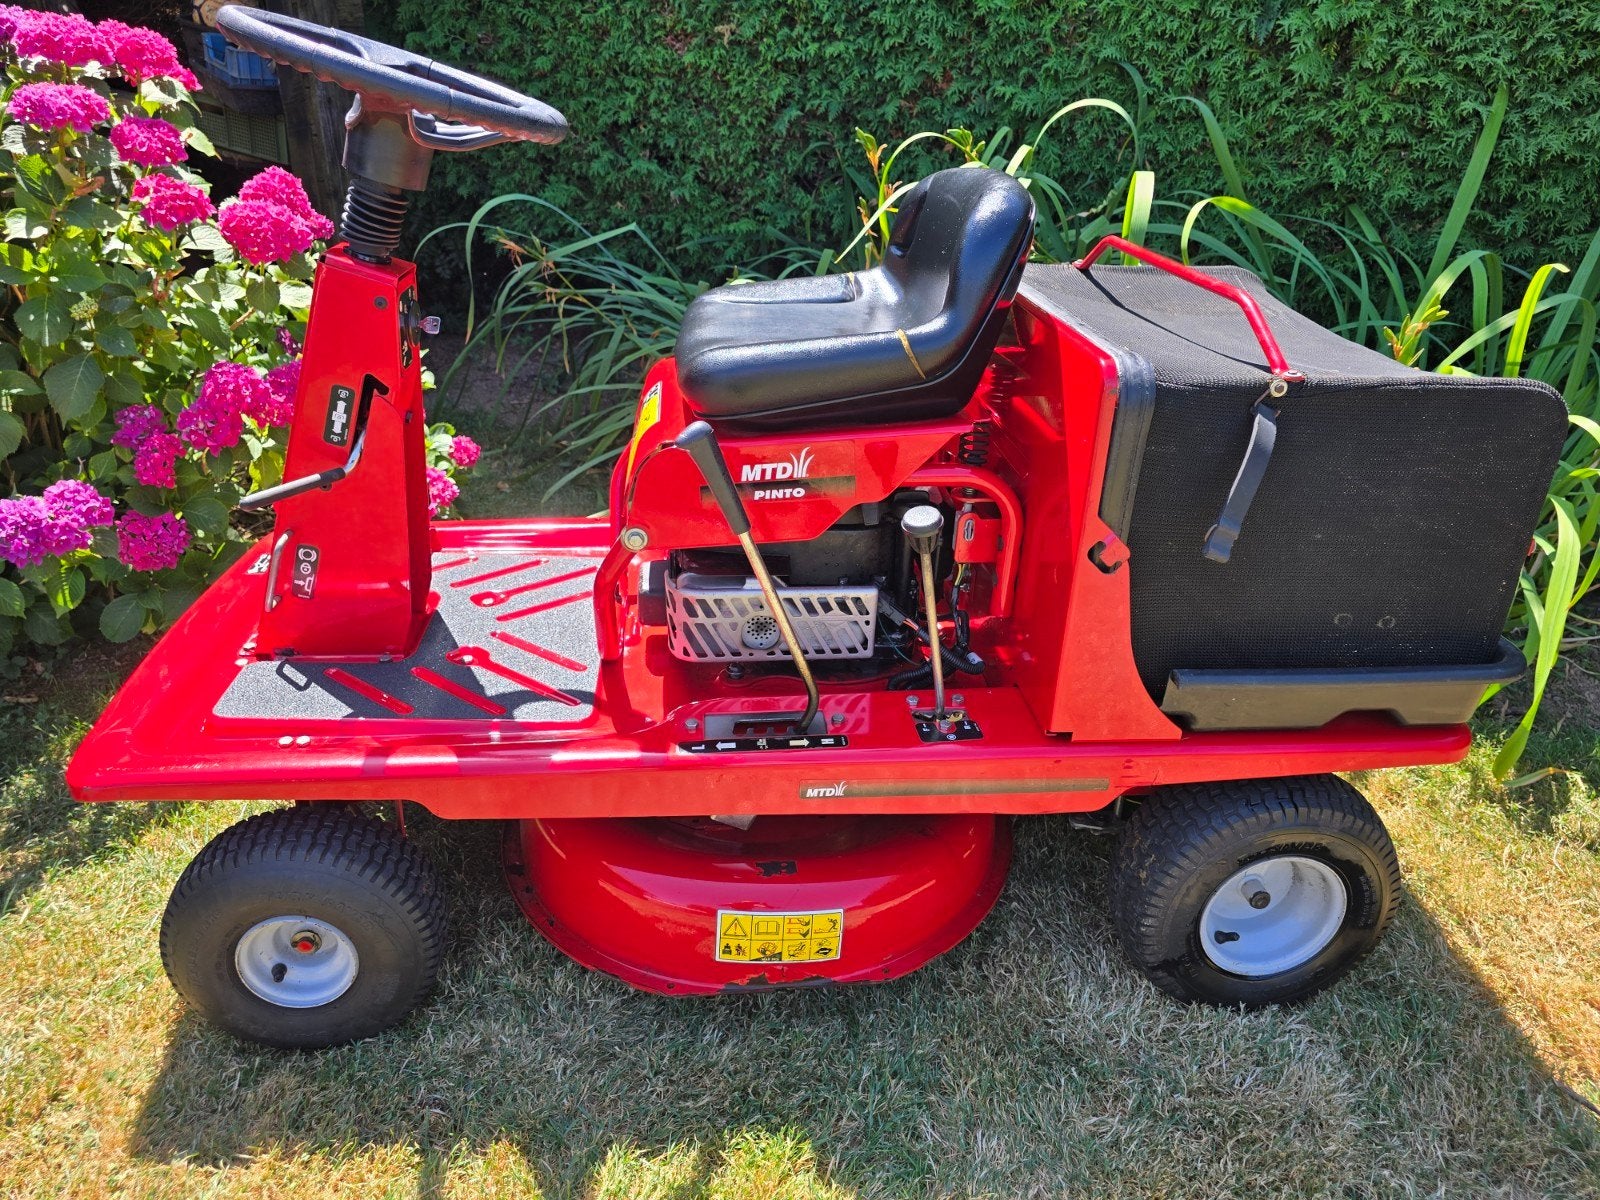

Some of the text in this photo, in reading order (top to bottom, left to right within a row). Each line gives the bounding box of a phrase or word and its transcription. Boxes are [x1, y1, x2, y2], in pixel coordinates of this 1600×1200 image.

[741, 462, 793, 481] MTD
[753, 488, 805, 500] PINTO
[806, 788, 835, 797] MTD
